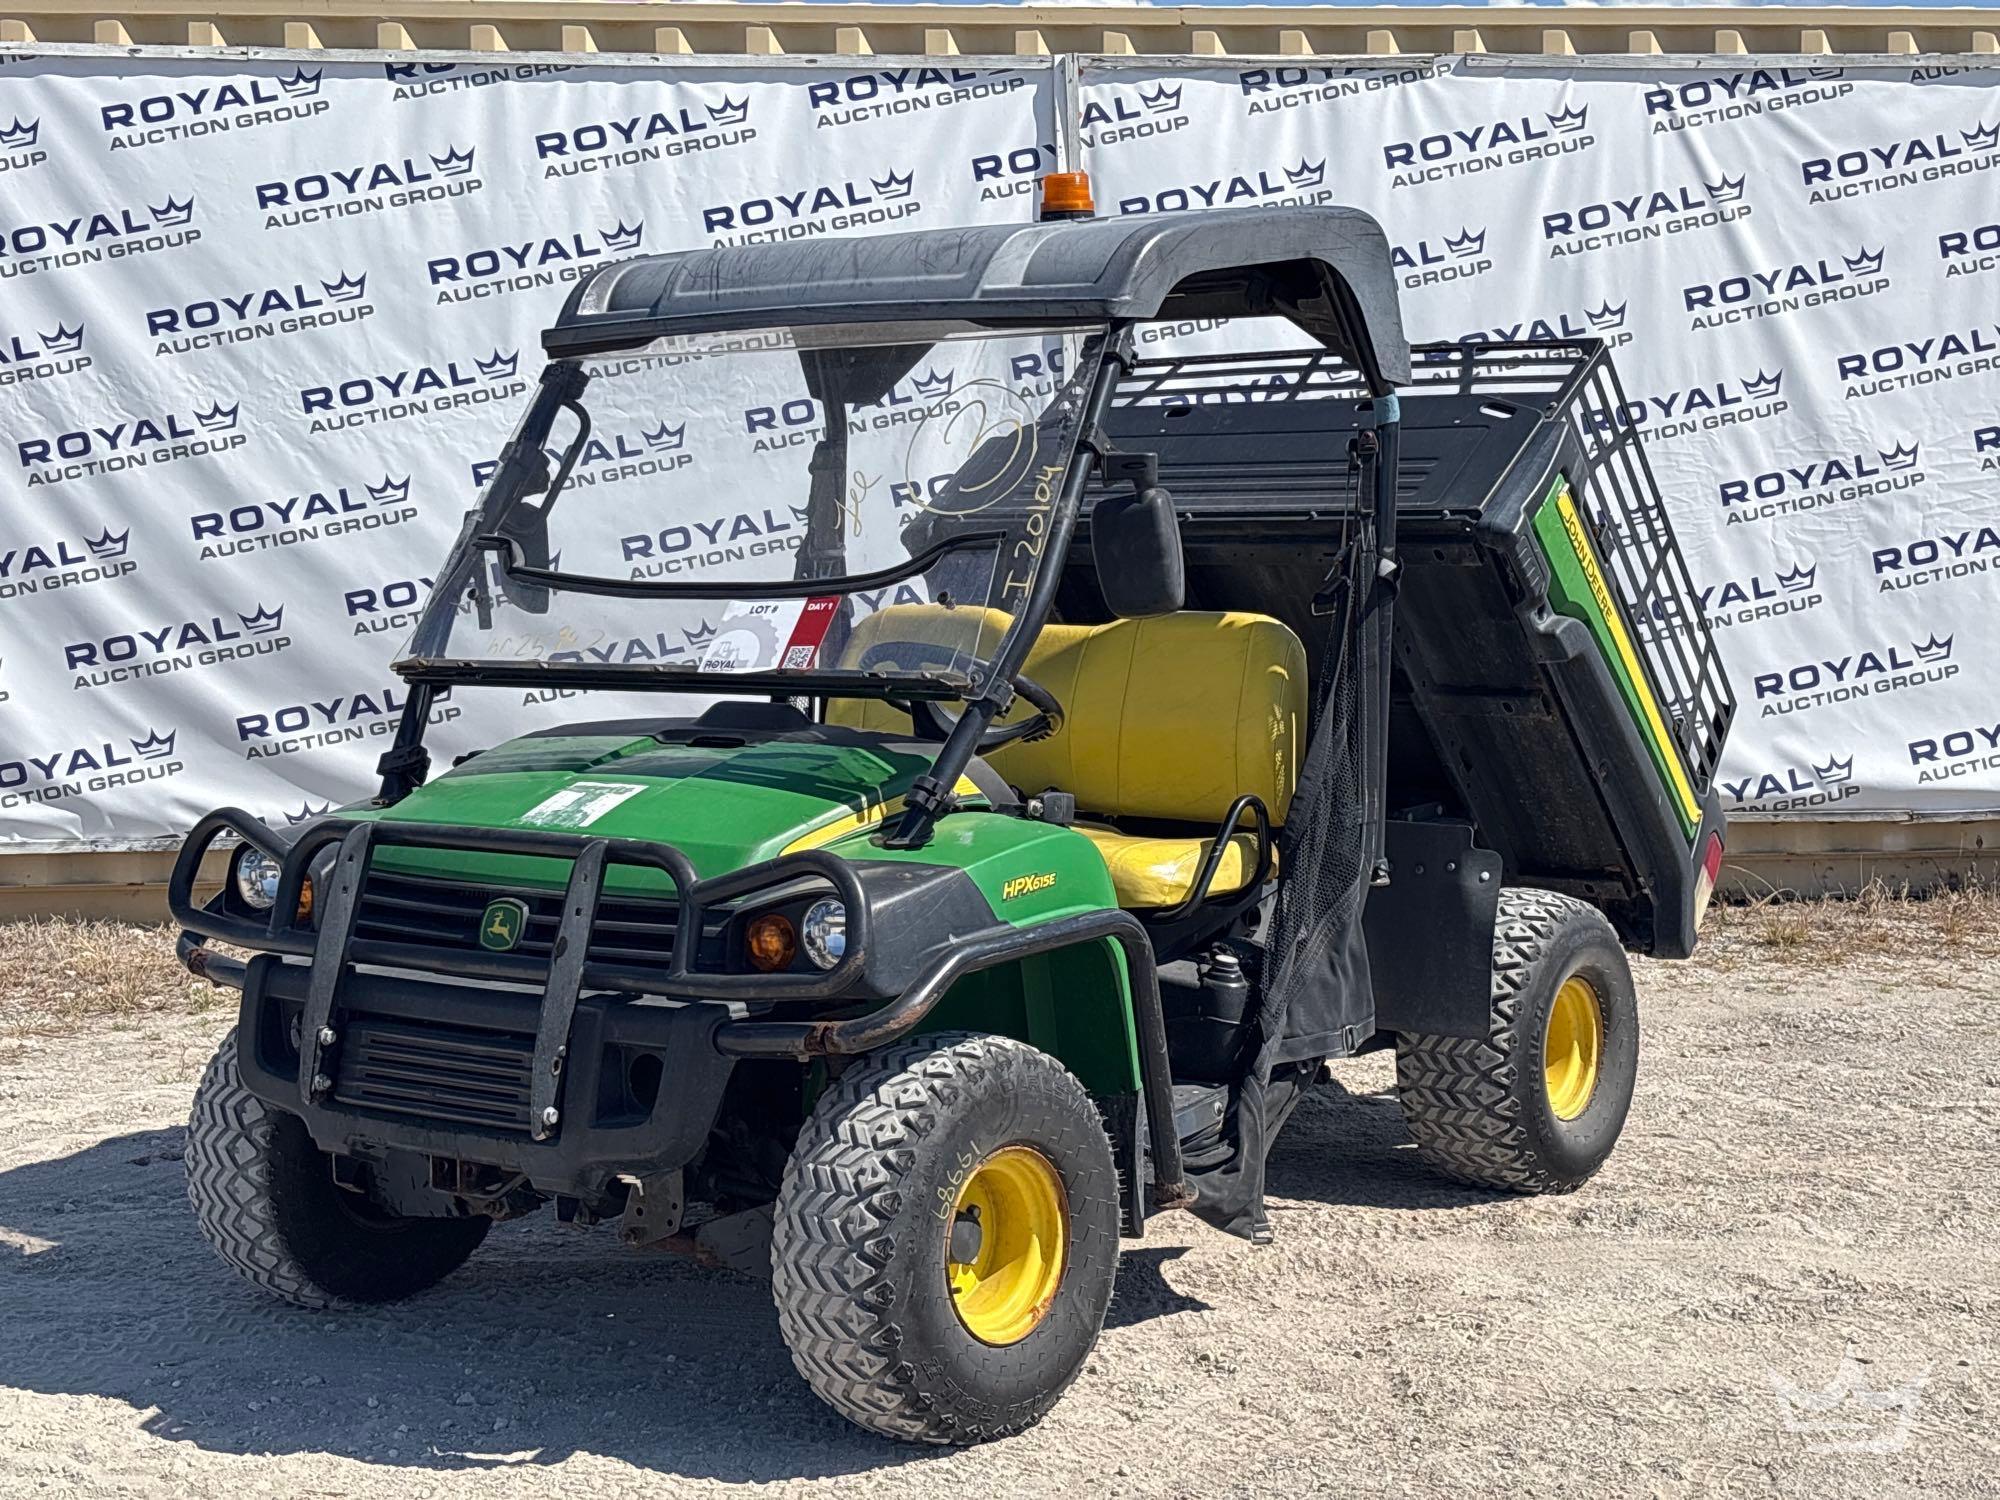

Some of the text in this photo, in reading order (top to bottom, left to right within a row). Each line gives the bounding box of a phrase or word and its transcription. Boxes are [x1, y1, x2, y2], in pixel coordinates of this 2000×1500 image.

[101, 80, 278, 131] ROYAL
[392, 67, 510, 102] AUCTION
[817, 77, 1025, 128] AUCTION GROUP
[1248, 82, 1359, 115] AUCTION
[1644, 68, 1805, 115] ROYAL
[1653, 83, 1853, 135] AUCTION GROUP
[110, 101, 329, 151] AUCTION GROUP
[535, 109, 707, 159] ROYAL
[1101, 116, 1189, 144] GROUP
[1384, 117, 1548, 169] ROYAL
[545, 129, 756, 179] AUCTION GROUP
[1392, 136, 1594, 189] AUCTION GROUP
[1802, 135, 1962, 185] ROYAL
[256, 159, 432, 209] ROYAL
[265, 179, 482, 229] AUCTION GROUP
[703, 182, 872, 233] ROYAL
[1810, 171, 1917, 204] AUCTION
[0, 210, 150, 257] OYAL
[832, 202, 920, 230] GROUP
[1543, 187, 1705, 239] ROYAL
[1551, 206, 1751, 258] AUCTION GROUP
[108, 230, 201, 258] GROUP
[428, 234, 601, 285] ROYAL
[437, 272, 553, 305] AUCTION
[1405, 260, 1492, 288] GROUP
[1684, 260, 1844, 312] ROYAL
[146, 285, 323, 336] ROYAL
[1692, 279, 1889, 331] AUCTION GROUP
[156, 305, 374, 356] AUCTION GROUP
[1142, 319, 1229, 343] GROUP
[1838, 330, 1996, 381] ROYAL
[0, 357, 92, 385] GROUP
[301, 363, 476, 414] ROYAL
[1846, 366, 1952, 400] AUCTION
[310, 382, 526, 434] AUCTION GROUP
[873, 401, 961, 429] GROUP
[1703, 401, 1788, 429] GROUP
[18, 415, 195, 467] ROYAL
[28, 435, 246, 487] AUCTION GROUP
[602, 455, 692, 482] GROUP
[1720, 455, 1879, 507] ROYAL
[191, 488, 367, 540] ROYAL
[1727, 473, 1924, 526] AUCTION GROUP
[200, 508, 417, 560] AUCTION GROUP
[621, 510, 791, 561] ROYAL
[43, 561, 137, 590] GROUP
[630, 547, 744, 580] AUCTION
[1562, 511, 1614, 624] JOHN DEERE
[1880, 559, 1987, 593] AUCTION
[749, 605, 769, 615] LOT
[808, 602, 826, 611] DAY
[1738, 595, 1822, 623] GROUP
[65, 618, 240, 670] ROYAL
[74, 637, 291, 690] AUCTION GROUP
[704, 660, 735, 669] ROYAL
[1754, 647, 1913, 699] ROYAL
[1762, 665, 1959, 718] AUCTION GROUP
[236, 689, 406, 741] ROYAL
[247, 726, 363, 760] AUCTION
[88, 762, 183, 791] GROUP
[1773, 783, 1860, 812] GROUP
[1002, 872, 1057, 901] HPX615E
